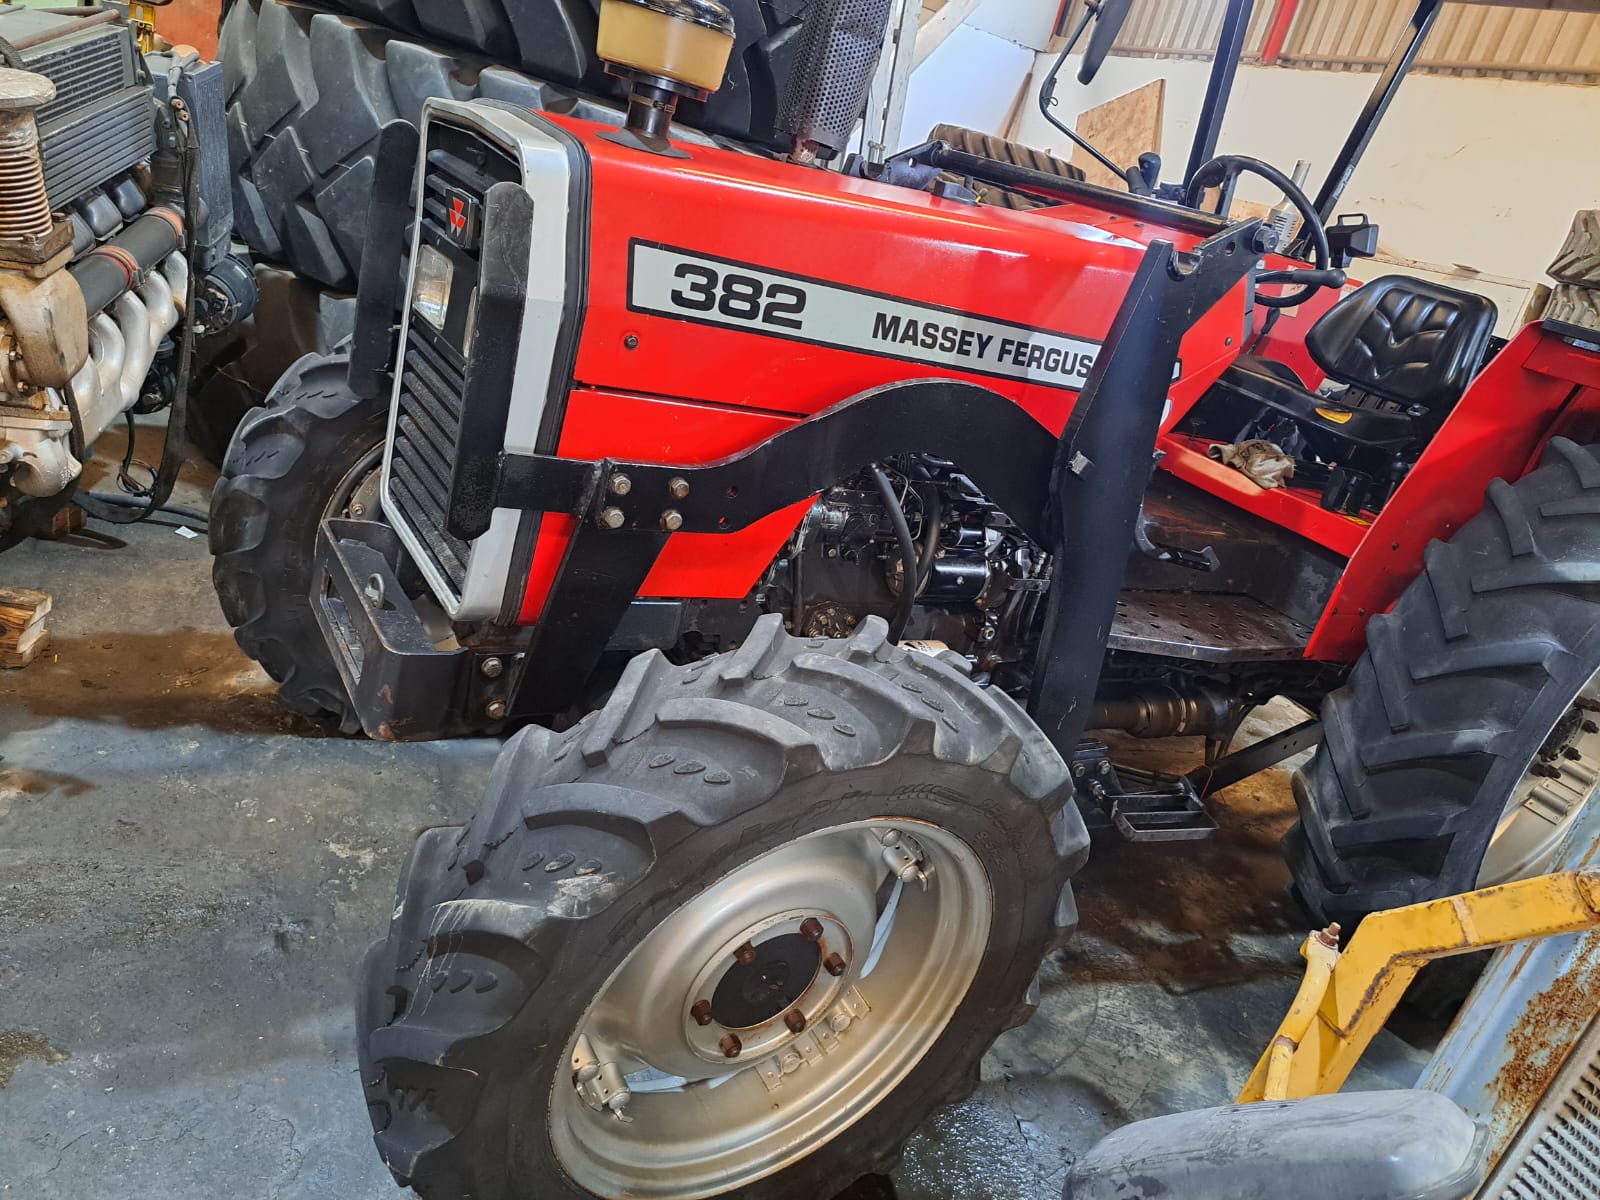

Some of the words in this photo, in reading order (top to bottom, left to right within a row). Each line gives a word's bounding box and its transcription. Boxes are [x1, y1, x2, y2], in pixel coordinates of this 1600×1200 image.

[671, 263, 807, 330] 382
[872, 312, 994, 359] MASSEY
[997, 338, 1093, 378] FERGUS
